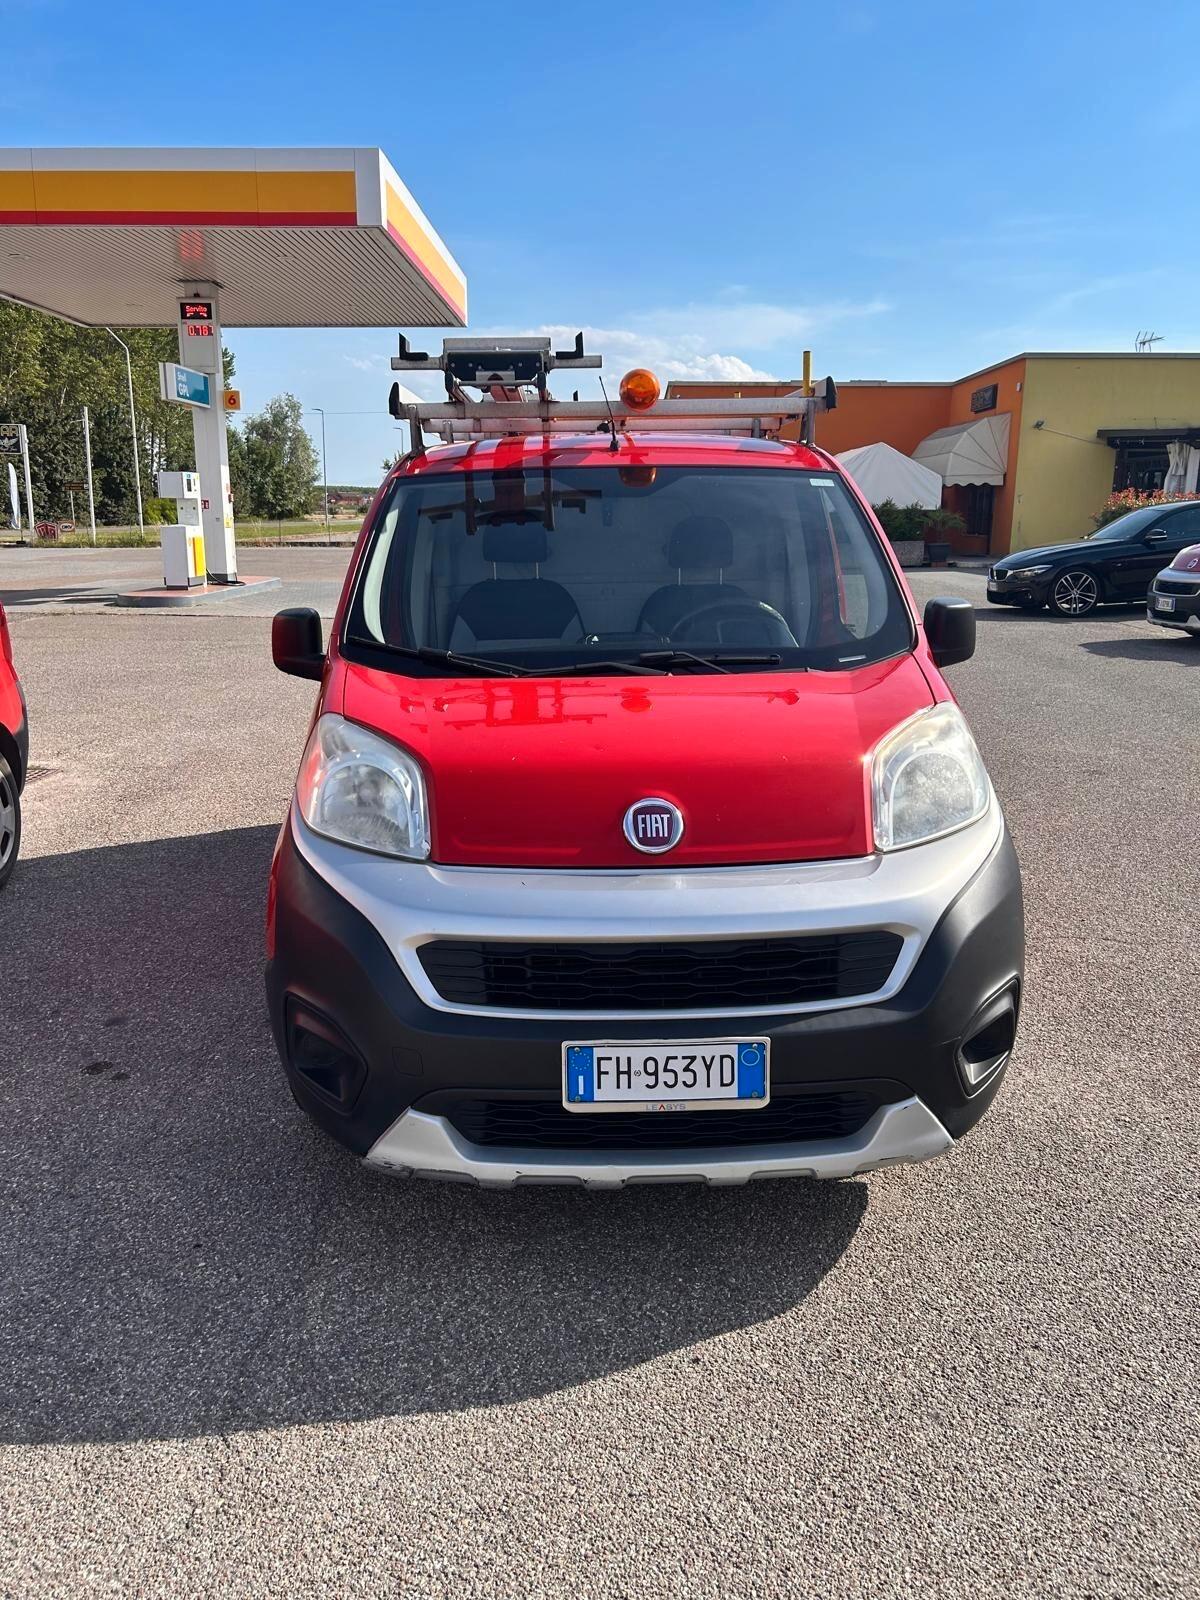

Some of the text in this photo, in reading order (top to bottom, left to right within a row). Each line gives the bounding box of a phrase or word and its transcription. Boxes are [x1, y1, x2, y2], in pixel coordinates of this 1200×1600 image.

[178, 383, 190, 397] GPL
[228, 395, 236, 405] 6
[637, 814, 670, 838] FIAT
[645, 1103, 687, 1111] LEASYS
